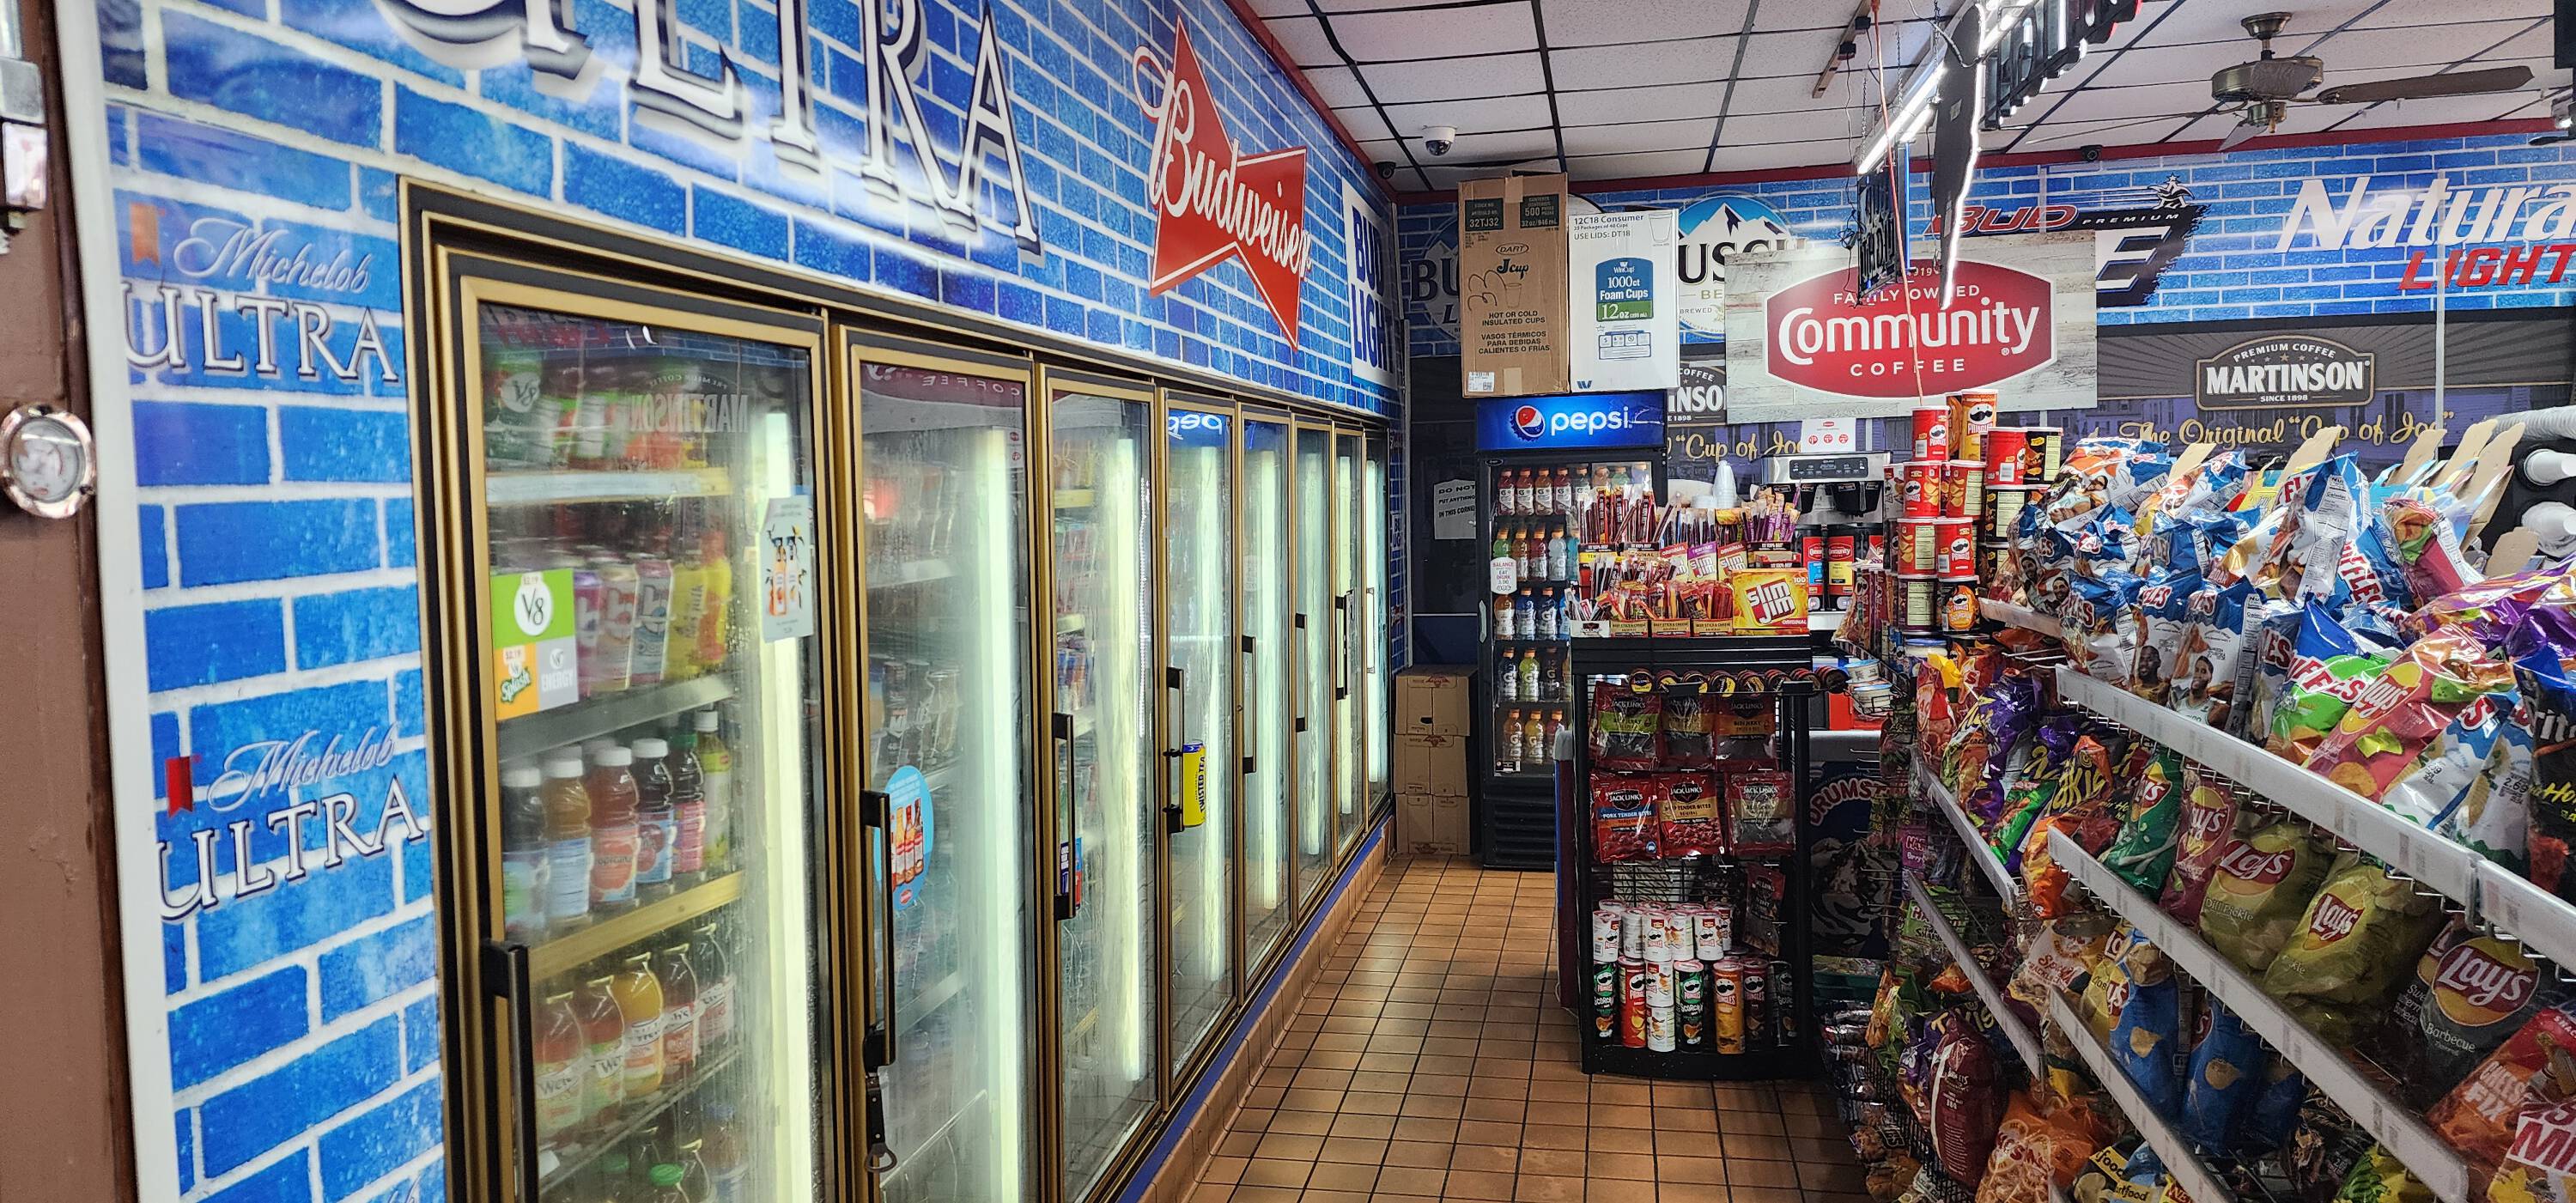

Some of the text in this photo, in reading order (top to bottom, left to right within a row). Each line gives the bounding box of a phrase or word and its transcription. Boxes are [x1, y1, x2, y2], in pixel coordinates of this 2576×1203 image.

[1133, 45, 1312, 282] Budweiser
[1469, 217, 1499, 228] 32TJ32
[1525, 207, 1540, 216] 500
[1574, 215, 1643, 225] 12C18 Consumer
[2081, 212, 2180, 225] PREMIUM
[2275, 175, 2576, 254] Natura
[1574, 232, 1589, 240] USE
[1590, 231, 1610, 240] LIDS:
[173, 217, 376, 294] Michelob
[1352, 204, 1385, 297] BUD
[1600, 288, 1649, 301] Foam Cups
[1910, 285, 1980, 301] OWED
[121, 282, 399, 382] ULTRA
[1481, 332, 1506, 341] VASOS
[1778, 296, 2040, 365] Community
[2233, 343, 2336, 362] PREMIUM COFFEE
[1850, 358, 1965, 377] COFFEE
[2206, 361, 2365, 395] MARTINSON
[1551, 406, 1631, 436] pepsi
[2119, 420, 2171, 445] The
[2178, 418, 2284, 451] Original
[2358, 415, 2384, 447] of
[1735, 433, 1758, 462] of
[1445, 508, 1457, 517] THIS
[522, 588, 544, 626] V8
[541, 668, 574, 693] ENERGY
[207, 721, 401, 812] Michelob
[1609, 793, 1625, 803] JACK
[1670, 787, 1686, 795] JACK
[2503, 777, 2529, 794] 2.69
[155, 772, 426, 921] ULTRA
[2223, 904, 2254, 921] Pickle
[2437, 946, 2532, 1006] Lay's
[2426, 1022, 2476, 1053] Barbecue
[2553, 1015, 2576, 1040] SNAC
[2509, 1120, 2576, 1174] MI
